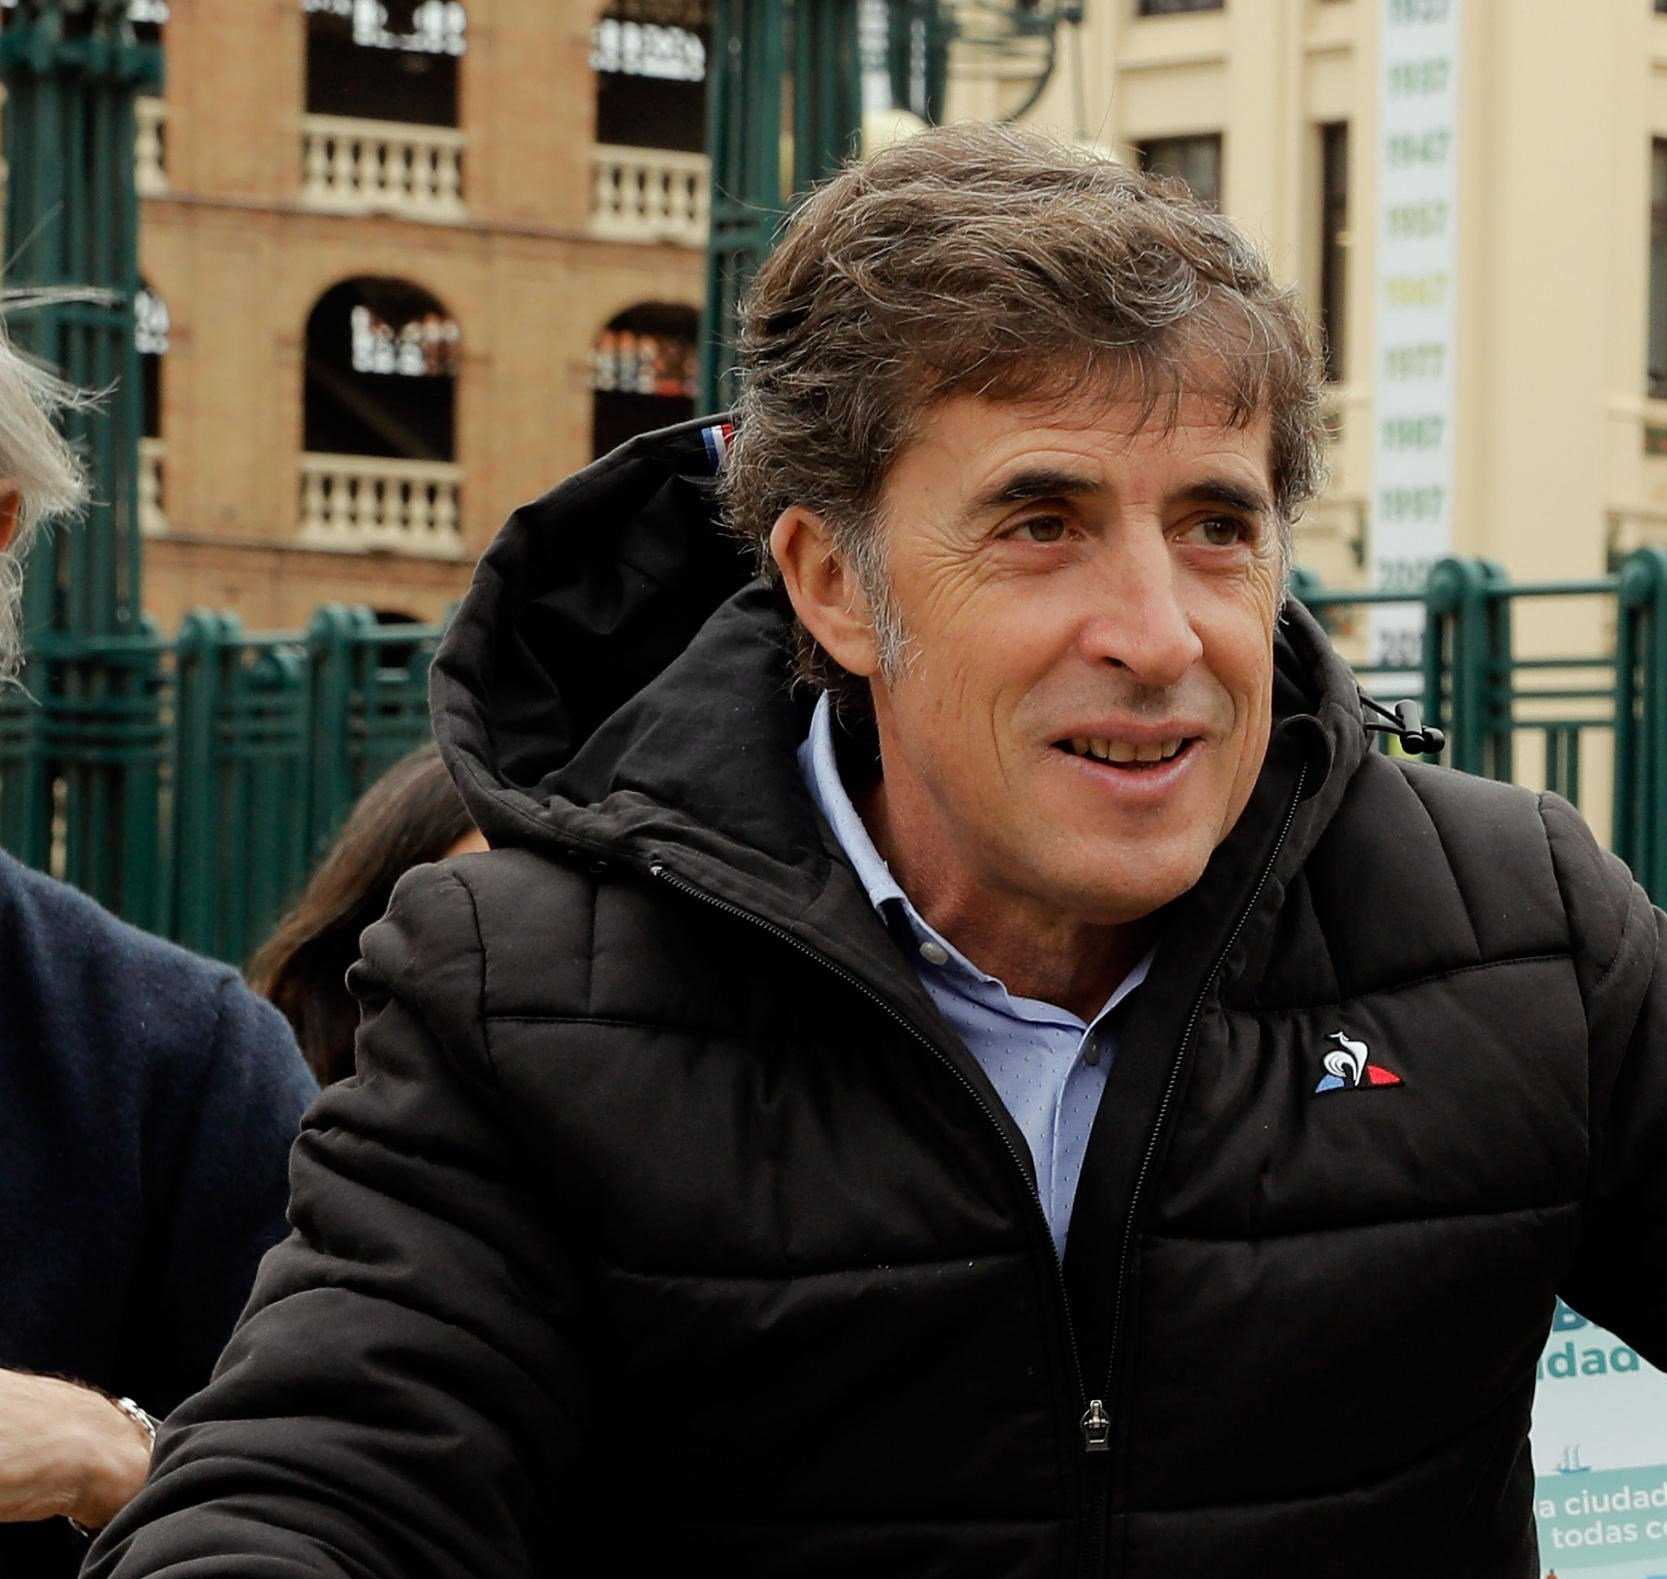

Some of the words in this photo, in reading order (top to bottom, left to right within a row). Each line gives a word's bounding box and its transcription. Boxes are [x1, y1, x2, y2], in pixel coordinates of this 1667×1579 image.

[1537, 1342, 1640, 1379] dad
[1539, 1500, 1556, 1519] a
[1552, 1520, 1638, 1549] todas
